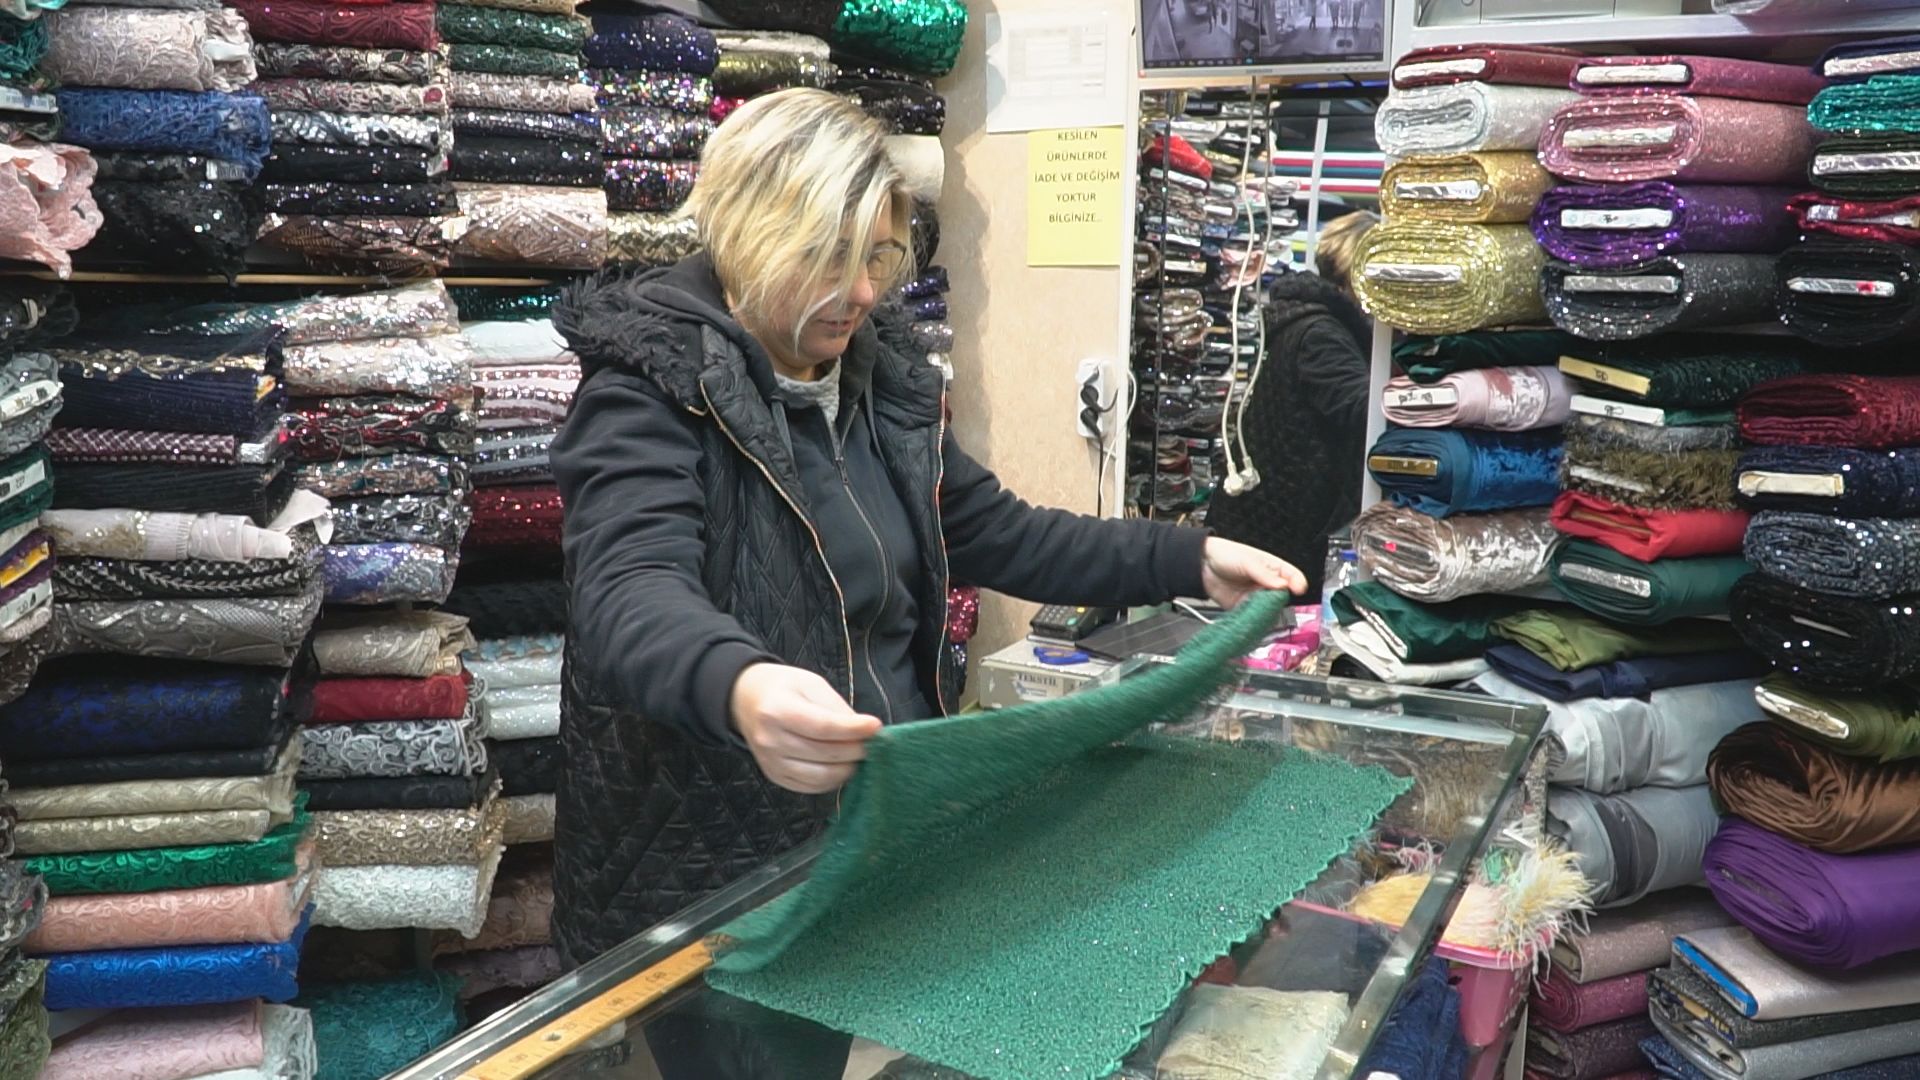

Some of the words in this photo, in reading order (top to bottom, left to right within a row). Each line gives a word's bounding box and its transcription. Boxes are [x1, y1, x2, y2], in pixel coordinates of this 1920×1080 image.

[1057, 129, 1098, 140] KESİLEN
[1046, 151, 1107, 161] ÜRÜNLERDE
[1034, 172, 1057, 182] İADE
[1061, 173, 1074, 182] VE
[1076, 169, 1120, 182] DEĞİŞİM
[1056, 192, 1097, 202] YOKTUR
